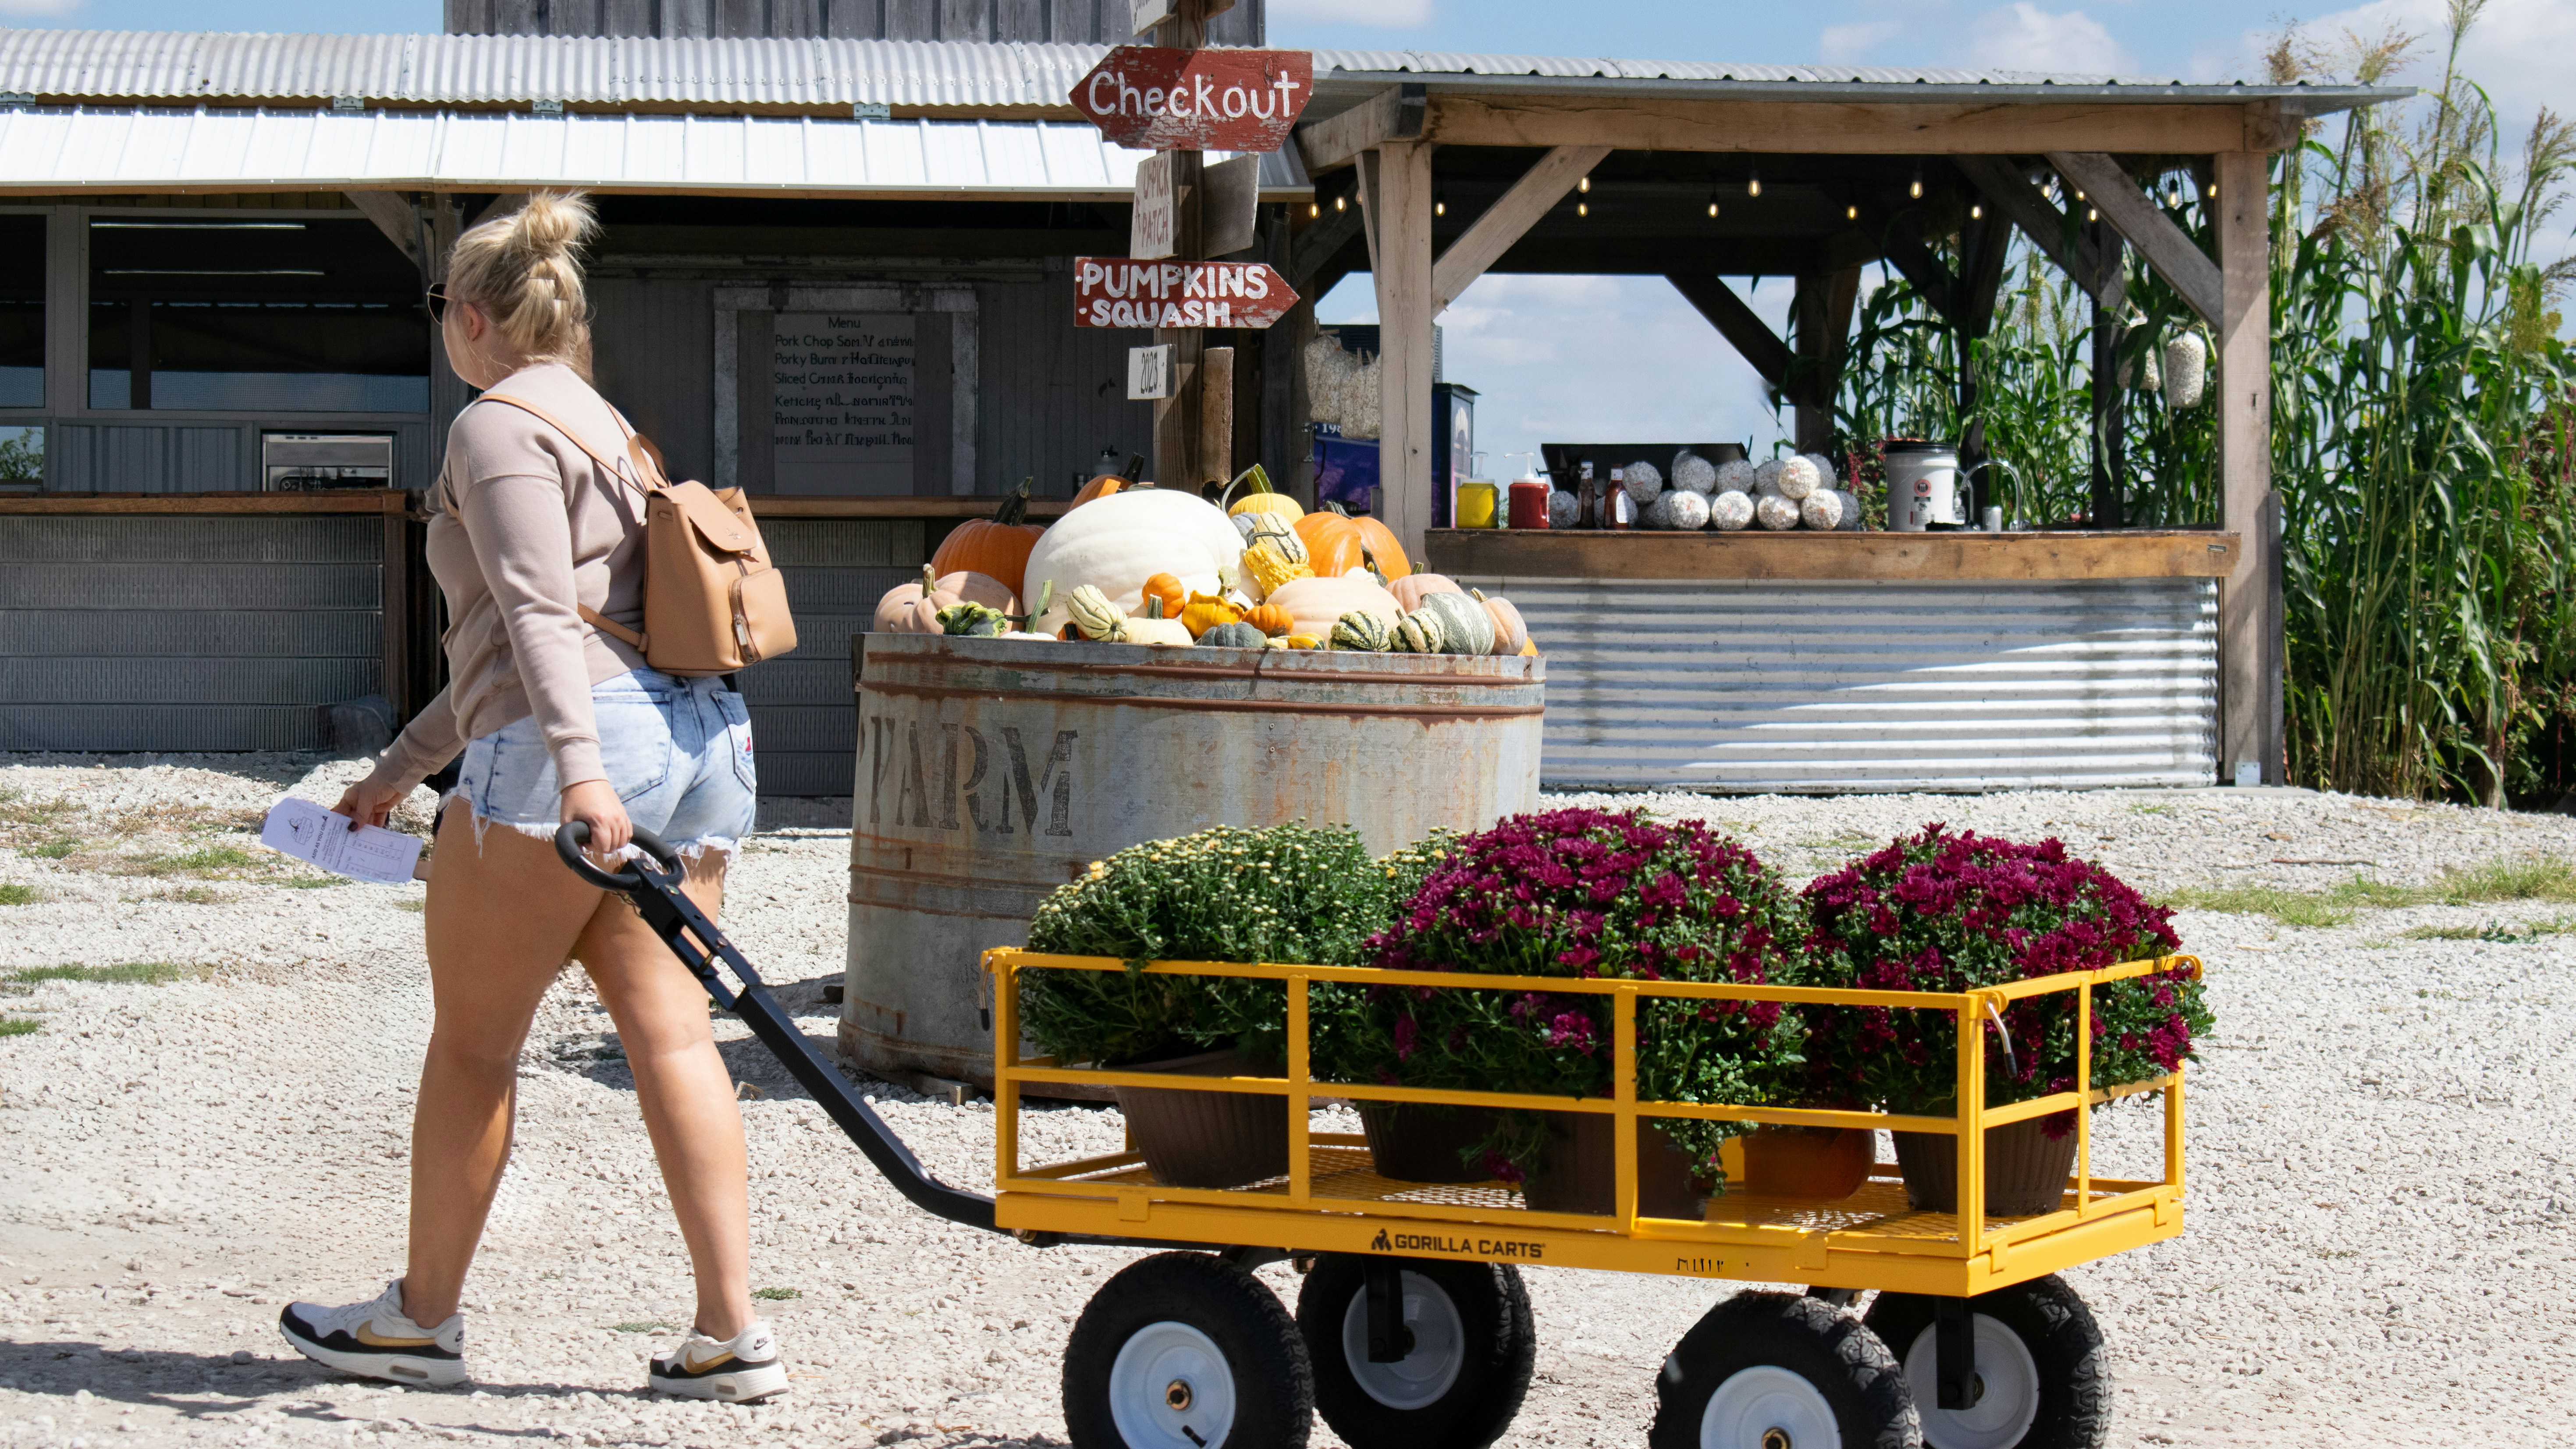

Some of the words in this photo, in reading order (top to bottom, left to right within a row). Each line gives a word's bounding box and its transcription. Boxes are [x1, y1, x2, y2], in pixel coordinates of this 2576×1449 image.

[1090, 71, 1300, 119] Checkout
[1143, 157, 1169, 200] U-PICK
[1141, 205, 1169, 248] PATCH
[1082, 263, 1268, 300] PUMPKINS
[828, 316, 861, 328] Menu
[1090, 299, 1230, 328] SQUASH
[775, 334, 799, 347] Pork
[803, 335, 833, 349] Chop
[775, 352, 807, 368] Porky
[1140, 351, 1158, 394] 2023
[775, 373, 806, 384] Sliced
[1395, 1233, 1473, 1253] GORILLA
[1478, 1239, 1542, 1258] CARTS
[757, 1336, 767, 1345] NIKE
